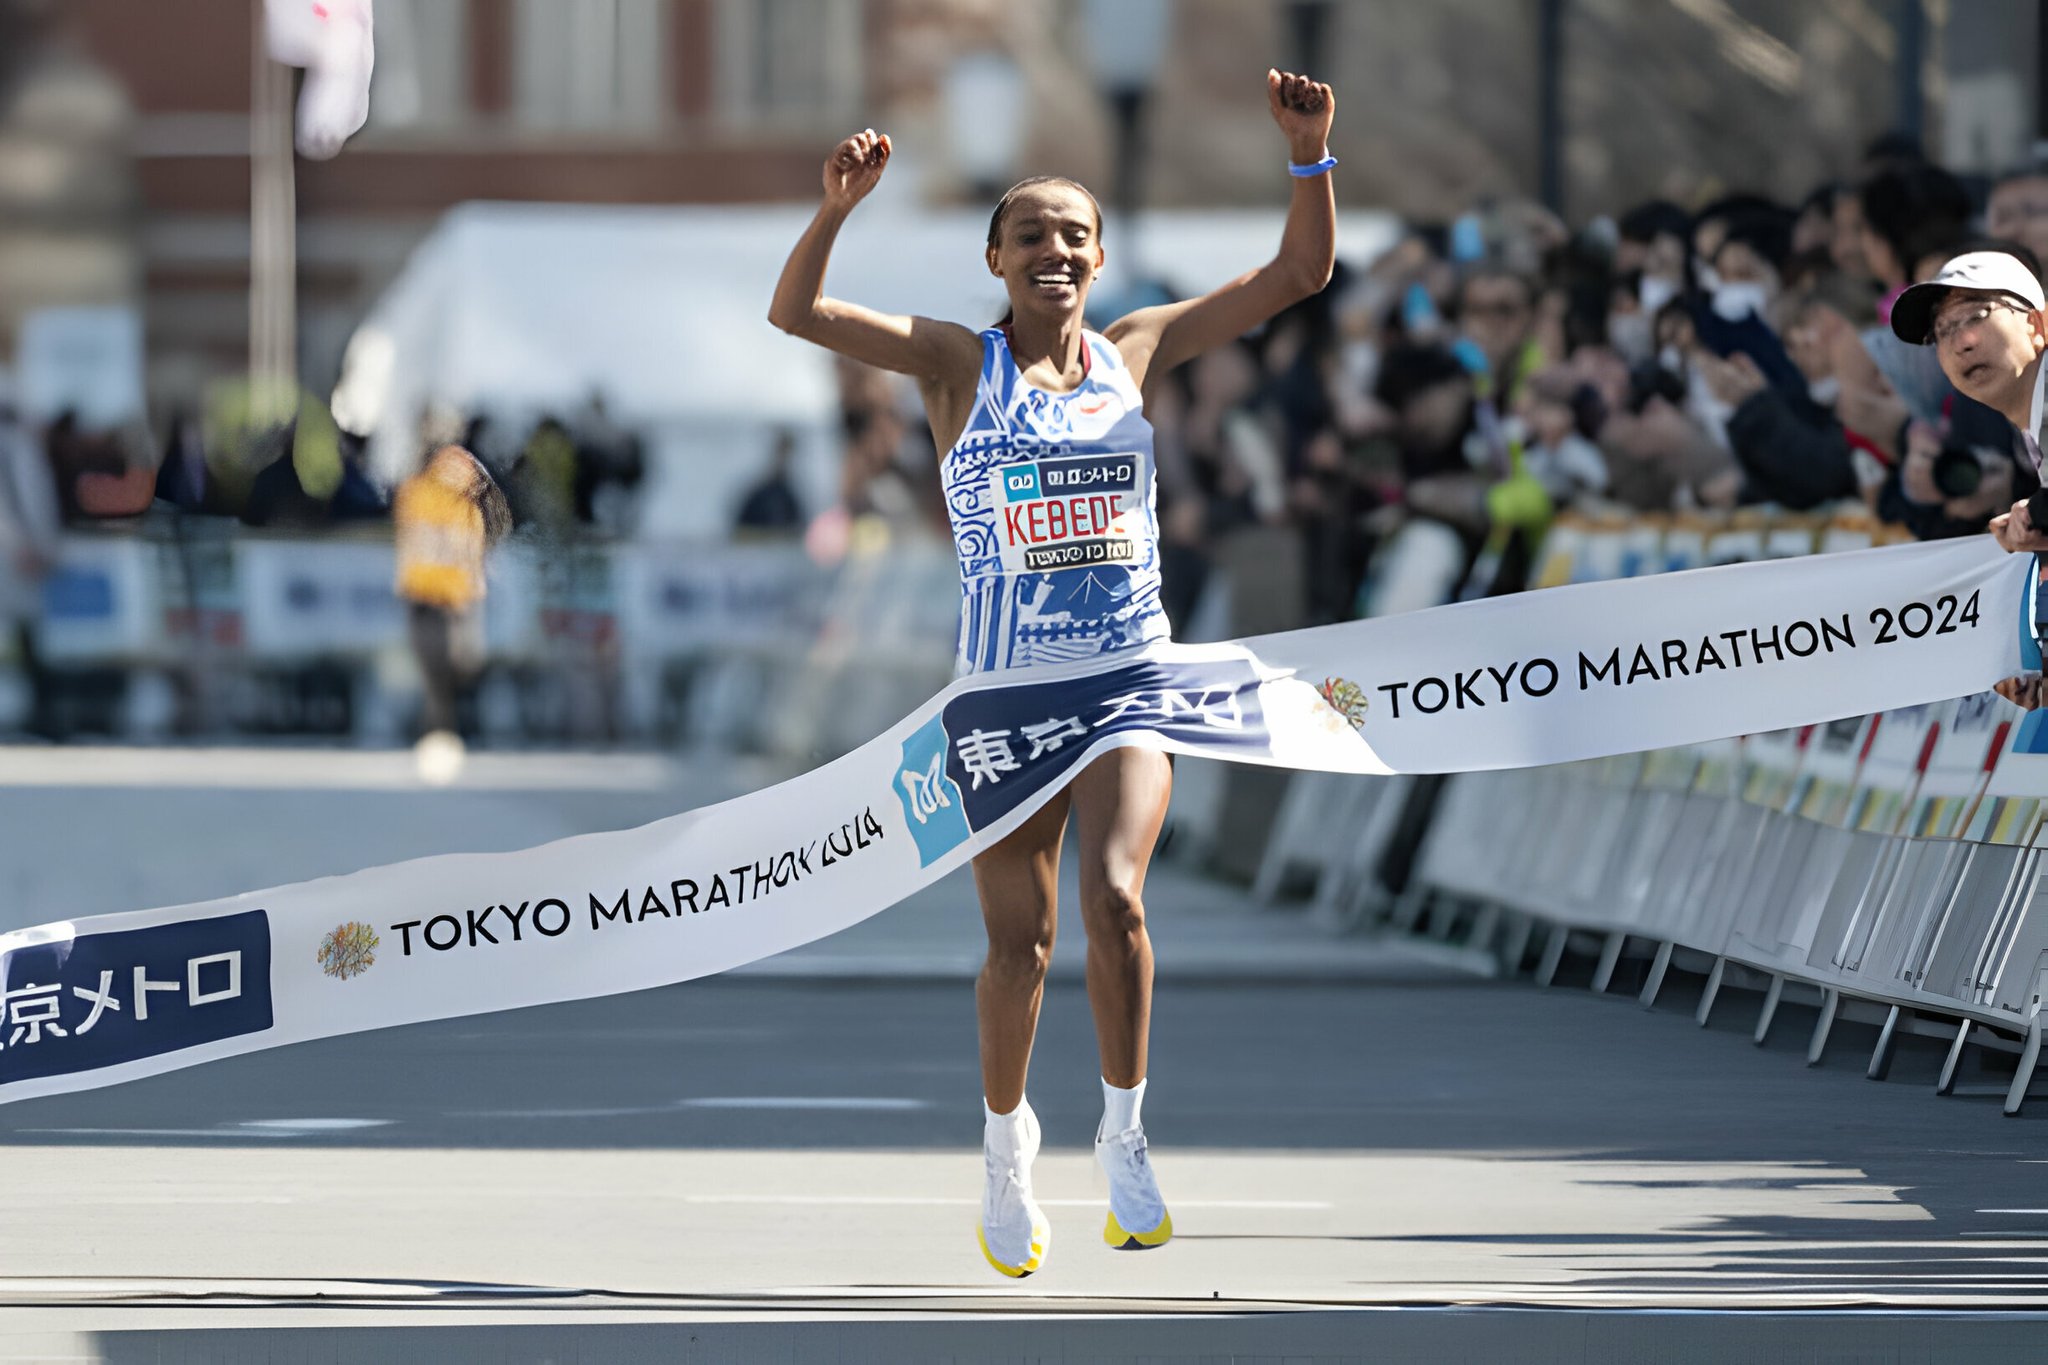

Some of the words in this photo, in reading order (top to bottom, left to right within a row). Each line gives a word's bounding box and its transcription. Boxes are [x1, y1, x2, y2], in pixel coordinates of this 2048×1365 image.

[1377, 657, 1559, 719] TOKYO
[1578, 613, 1857, 691] MARATHON
[1869, 588, 1981, 645] 2024
[390, 898, 571, 956] TOKYO
[0, 950, 242, 1049] 京メトロ
